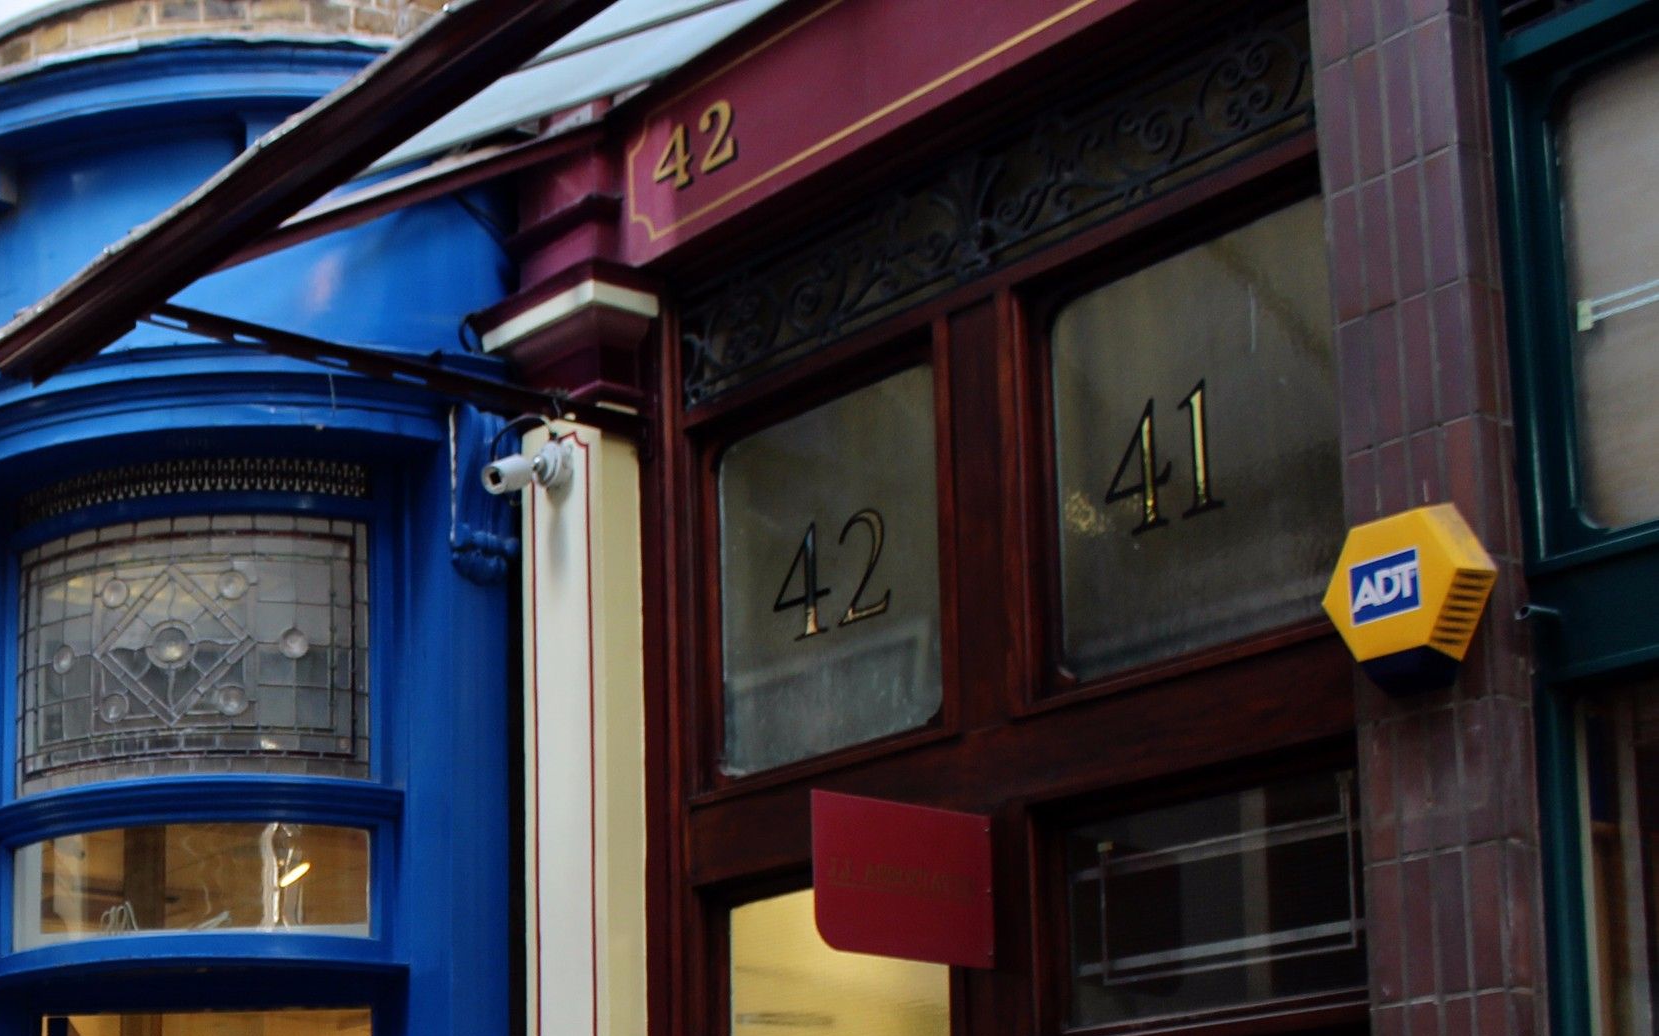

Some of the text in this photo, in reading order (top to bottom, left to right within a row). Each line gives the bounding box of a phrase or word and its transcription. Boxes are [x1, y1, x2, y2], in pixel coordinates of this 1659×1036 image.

[653, 98, 739, 190] 42
[1104, 377, 1225, 537] 41
[773, 507, 892, 642] 42
[1352, 559, 1418, 614] ADT
